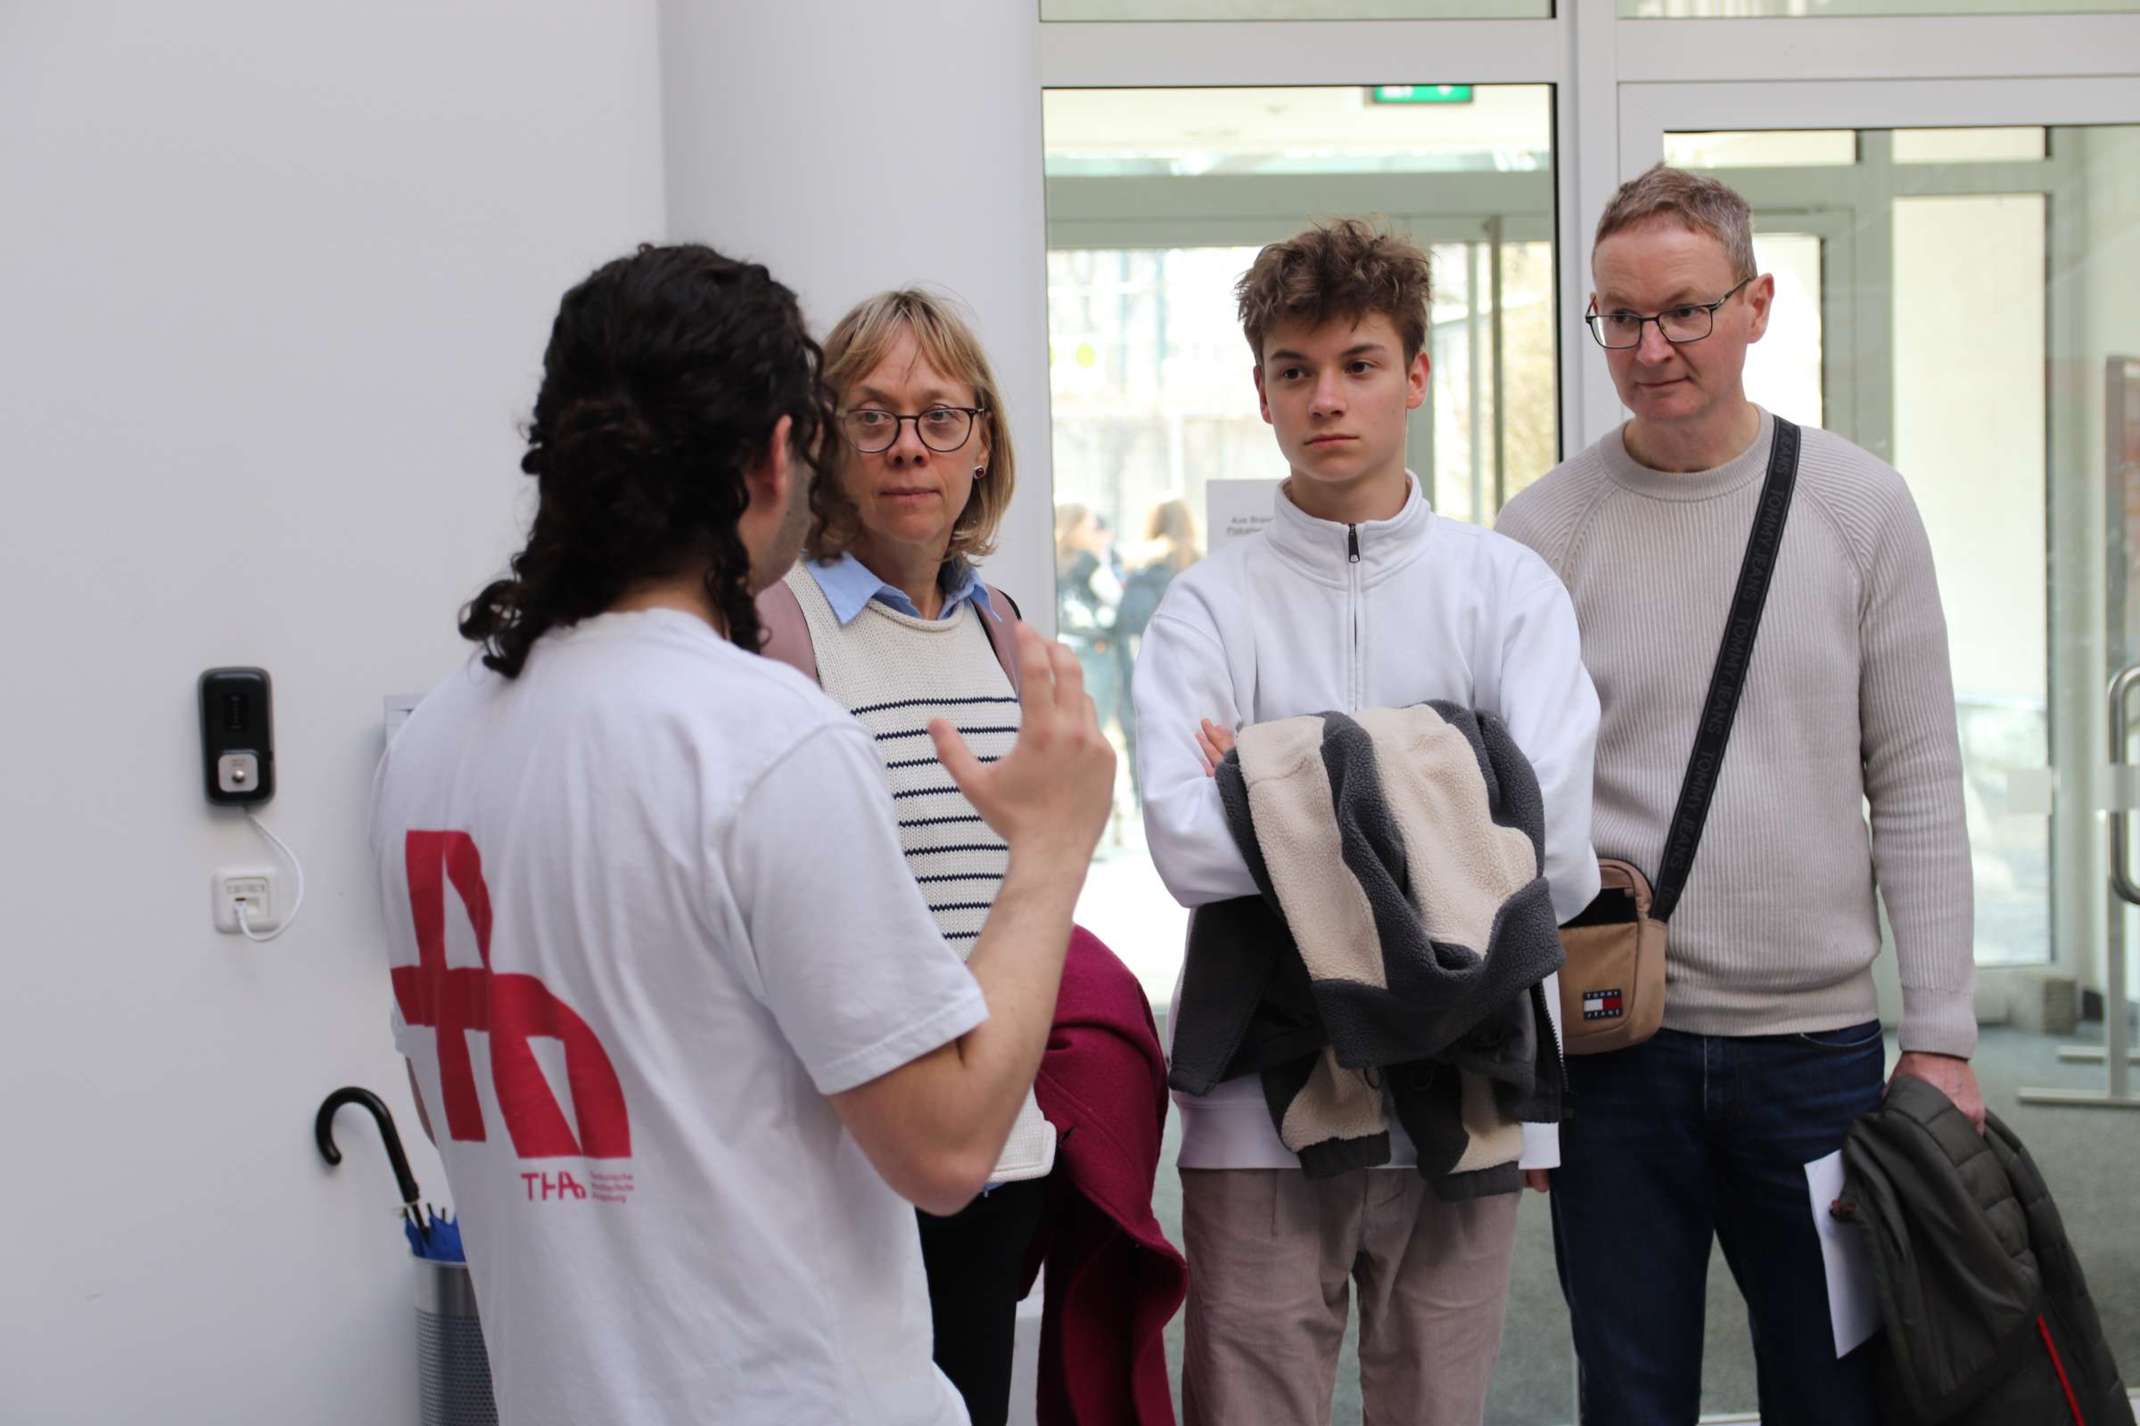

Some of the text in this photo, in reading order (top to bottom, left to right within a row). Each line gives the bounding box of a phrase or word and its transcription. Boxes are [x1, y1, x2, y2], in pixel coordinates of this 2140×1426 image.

[1742, 489, 1785, 601] TOMMY JEANS
[1706, 616, 1753, 735] TOMMY JEANS
[1683, 750, 1716, 815] TOMMY
[1669, 815, 1696, 868] JEANS
[1587, 1009, 1619, 1017] JEANS
